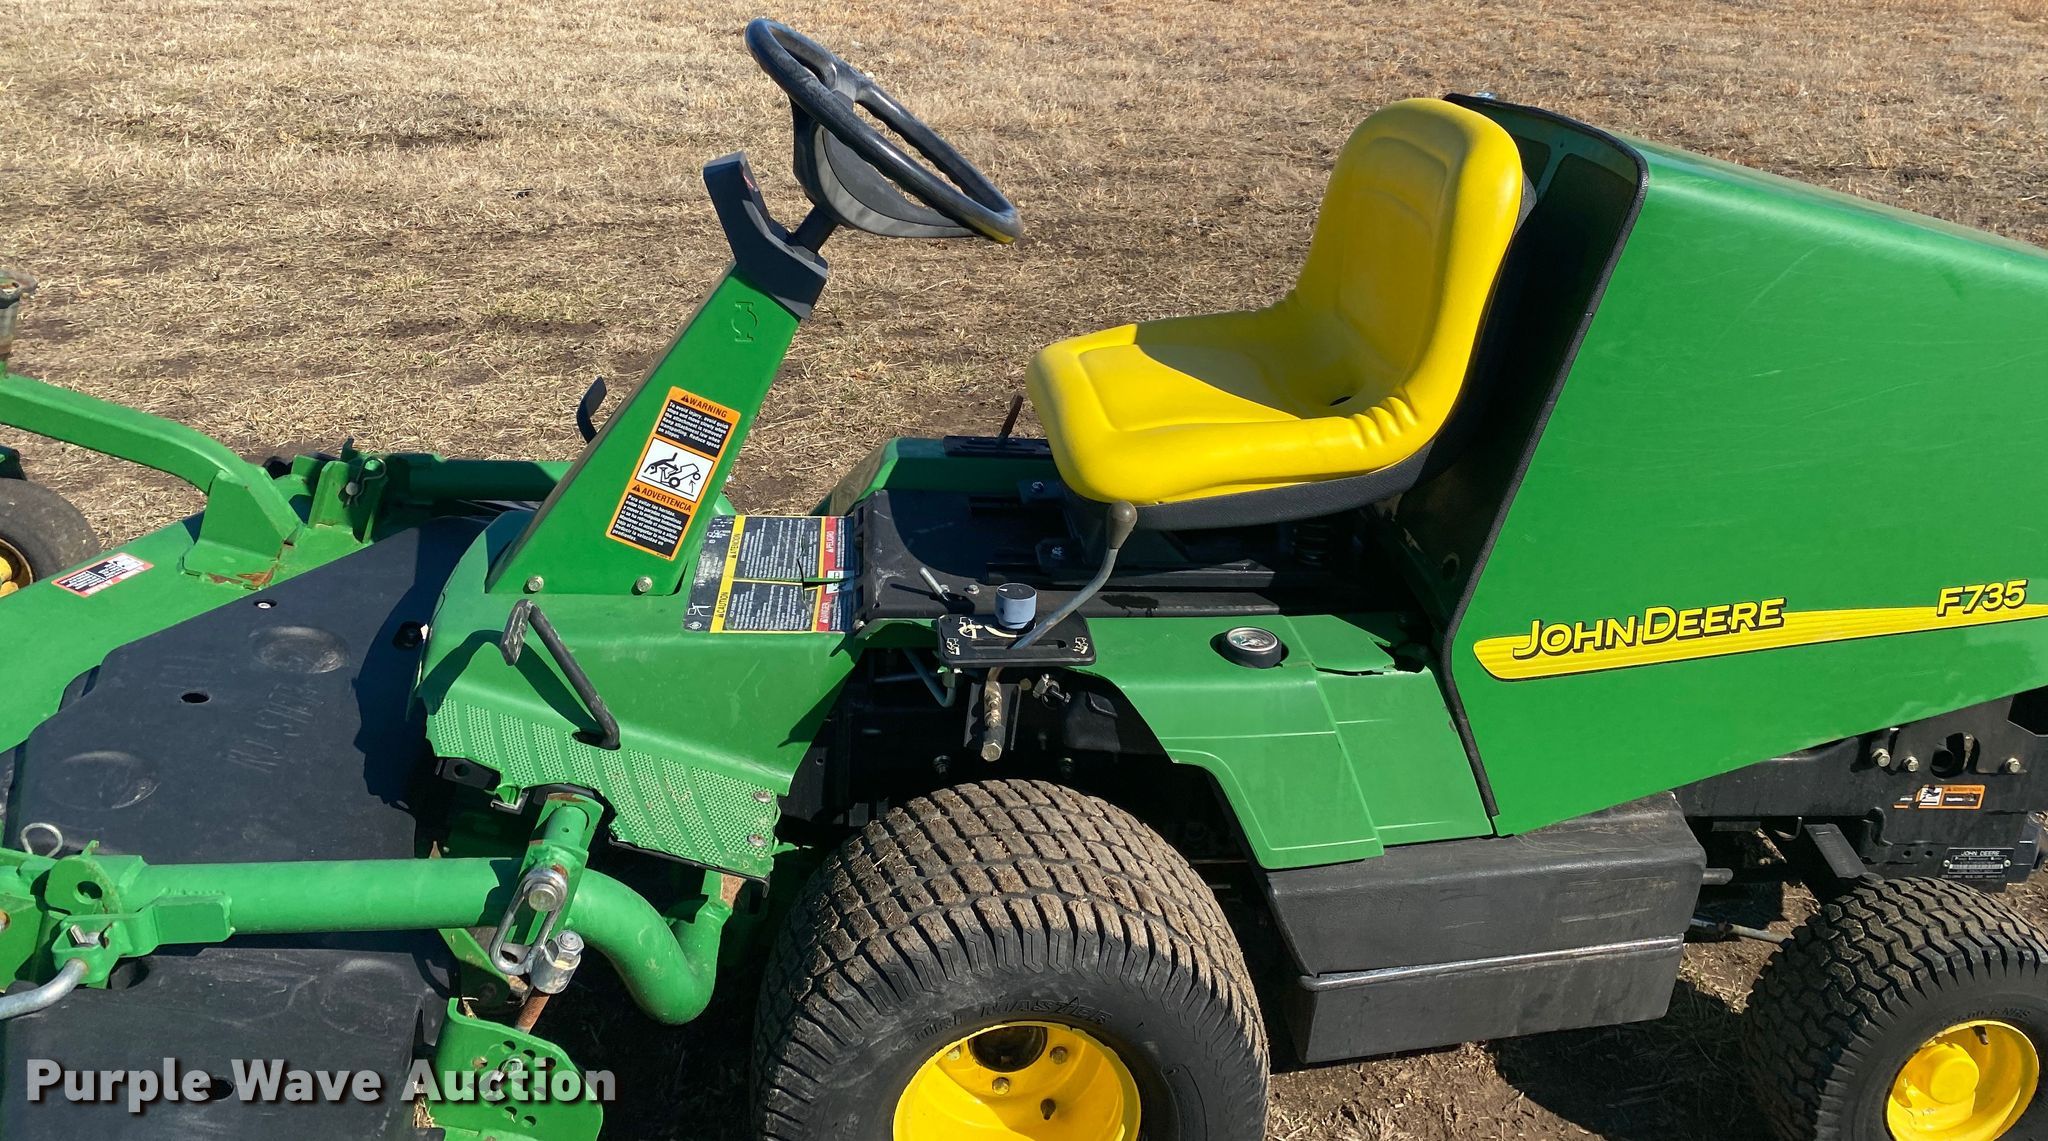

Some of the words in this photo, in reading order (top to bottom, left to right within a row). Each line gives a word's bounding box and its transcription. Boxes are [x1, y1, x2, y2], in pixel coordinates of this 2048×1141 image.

[688, 397, 728, 417] WARNING
[641, 487, 692, 512] ADVERTENCIA
[717, 591, 729, 614] CAUTION
[1937, 579, 2028, 617] F735
[1513, 616, 1638, 660] JOHN
[1642, 597, 1786, 644] DEERE
